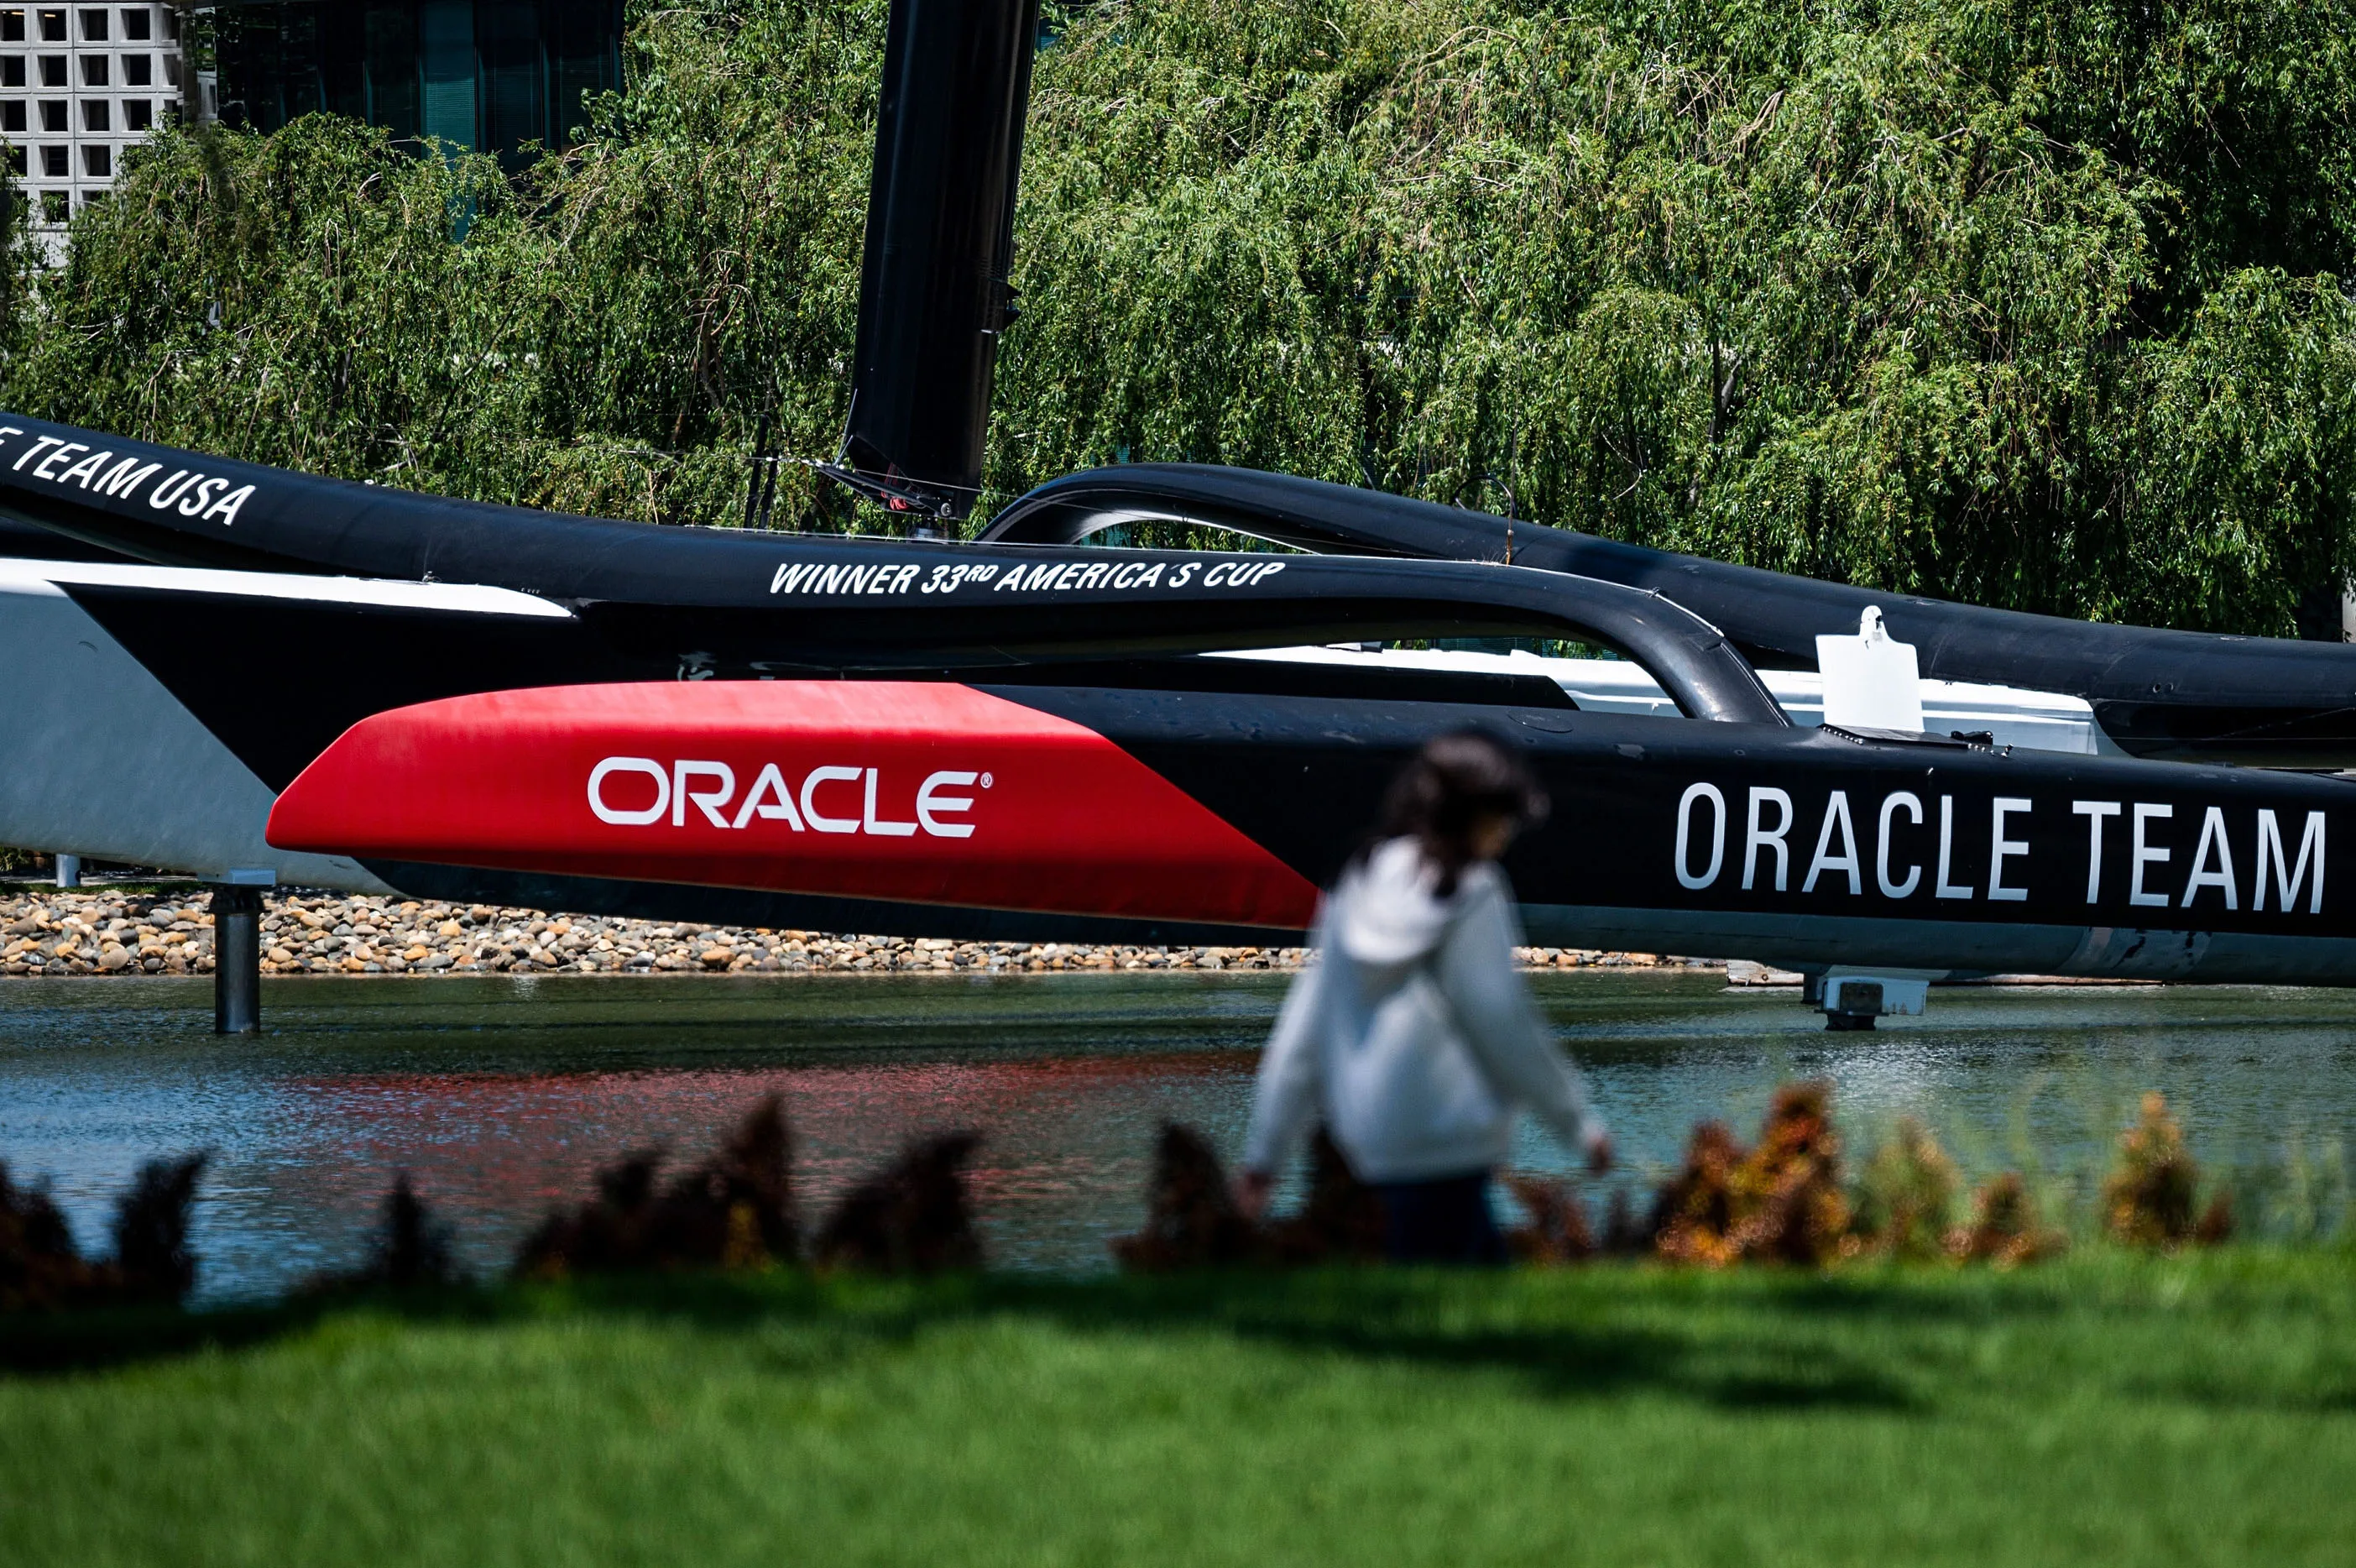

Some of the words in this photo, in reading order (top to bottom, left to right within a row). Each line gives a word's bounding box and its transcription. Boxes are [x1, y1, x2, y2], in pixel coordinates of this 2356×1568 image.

[12, 435, 164, 499] TEAM
[149, 469, 256, 526] USA
[769, 562, 921, 594] WINNER
[993, 562, 1203, 593] AMERICA'S
[1203, 562, 1286, 588] CUP
[1674, 781, 2032, 901] ORACLE
[2072, 800, 2327, 914] TEAM
